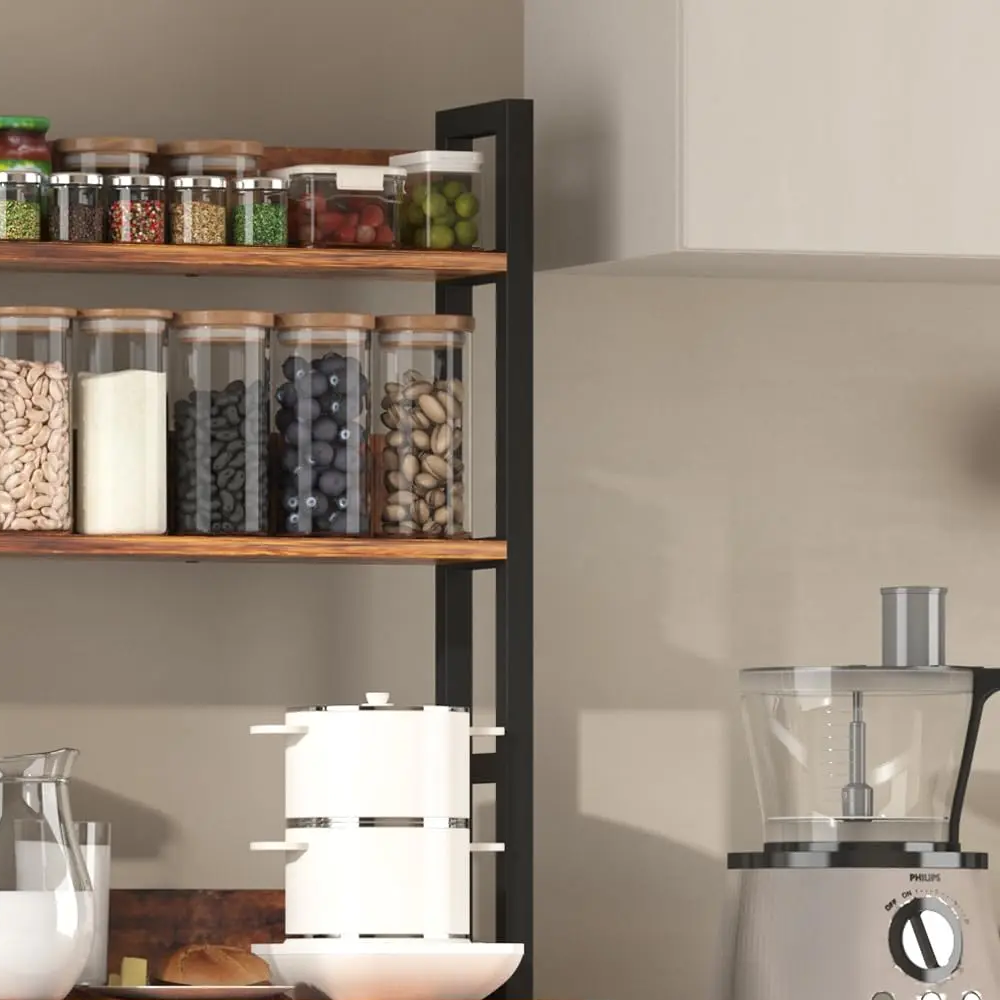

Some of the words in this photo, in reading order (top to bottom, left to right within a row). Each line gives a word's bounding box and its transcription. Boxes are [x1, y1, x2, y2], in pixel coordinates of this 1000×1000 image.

[909, 873, 941, 882] PHILIPS
[901, 890, 912, 899] ON
[884, 898, 898, 912] OFF
